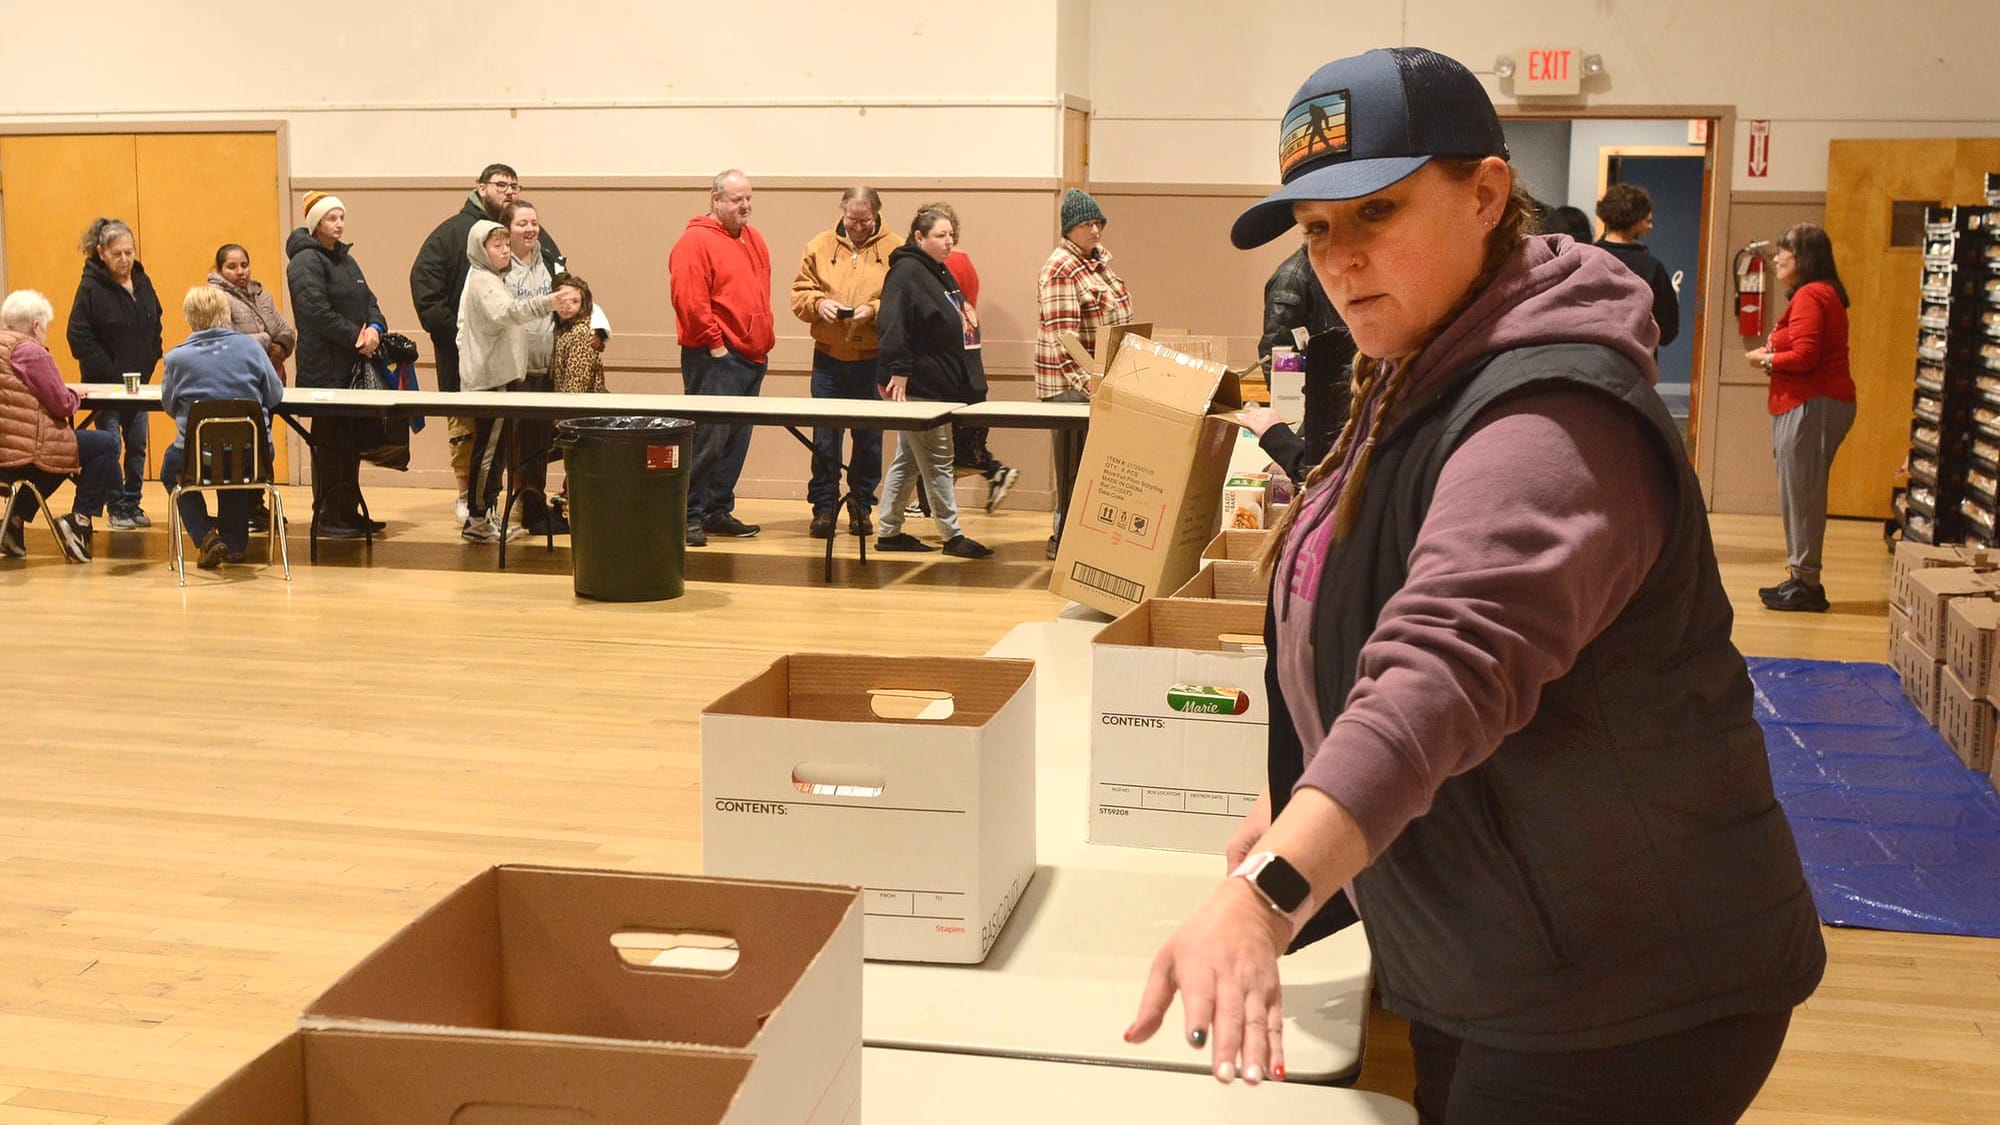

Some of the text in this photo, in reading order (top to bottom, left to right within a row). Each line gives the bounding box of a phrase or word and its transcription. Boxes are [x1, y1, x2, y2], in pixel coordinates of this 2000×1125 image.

[1528, 50, 1571, 80] EXIT
[1180, 700, 1220, 713] Marie
[1102, 715, 1166, 729] CONTENTS:
[715, 800, 788, 815] CONTENTS:
[936, 924, 965, 935] Staples
